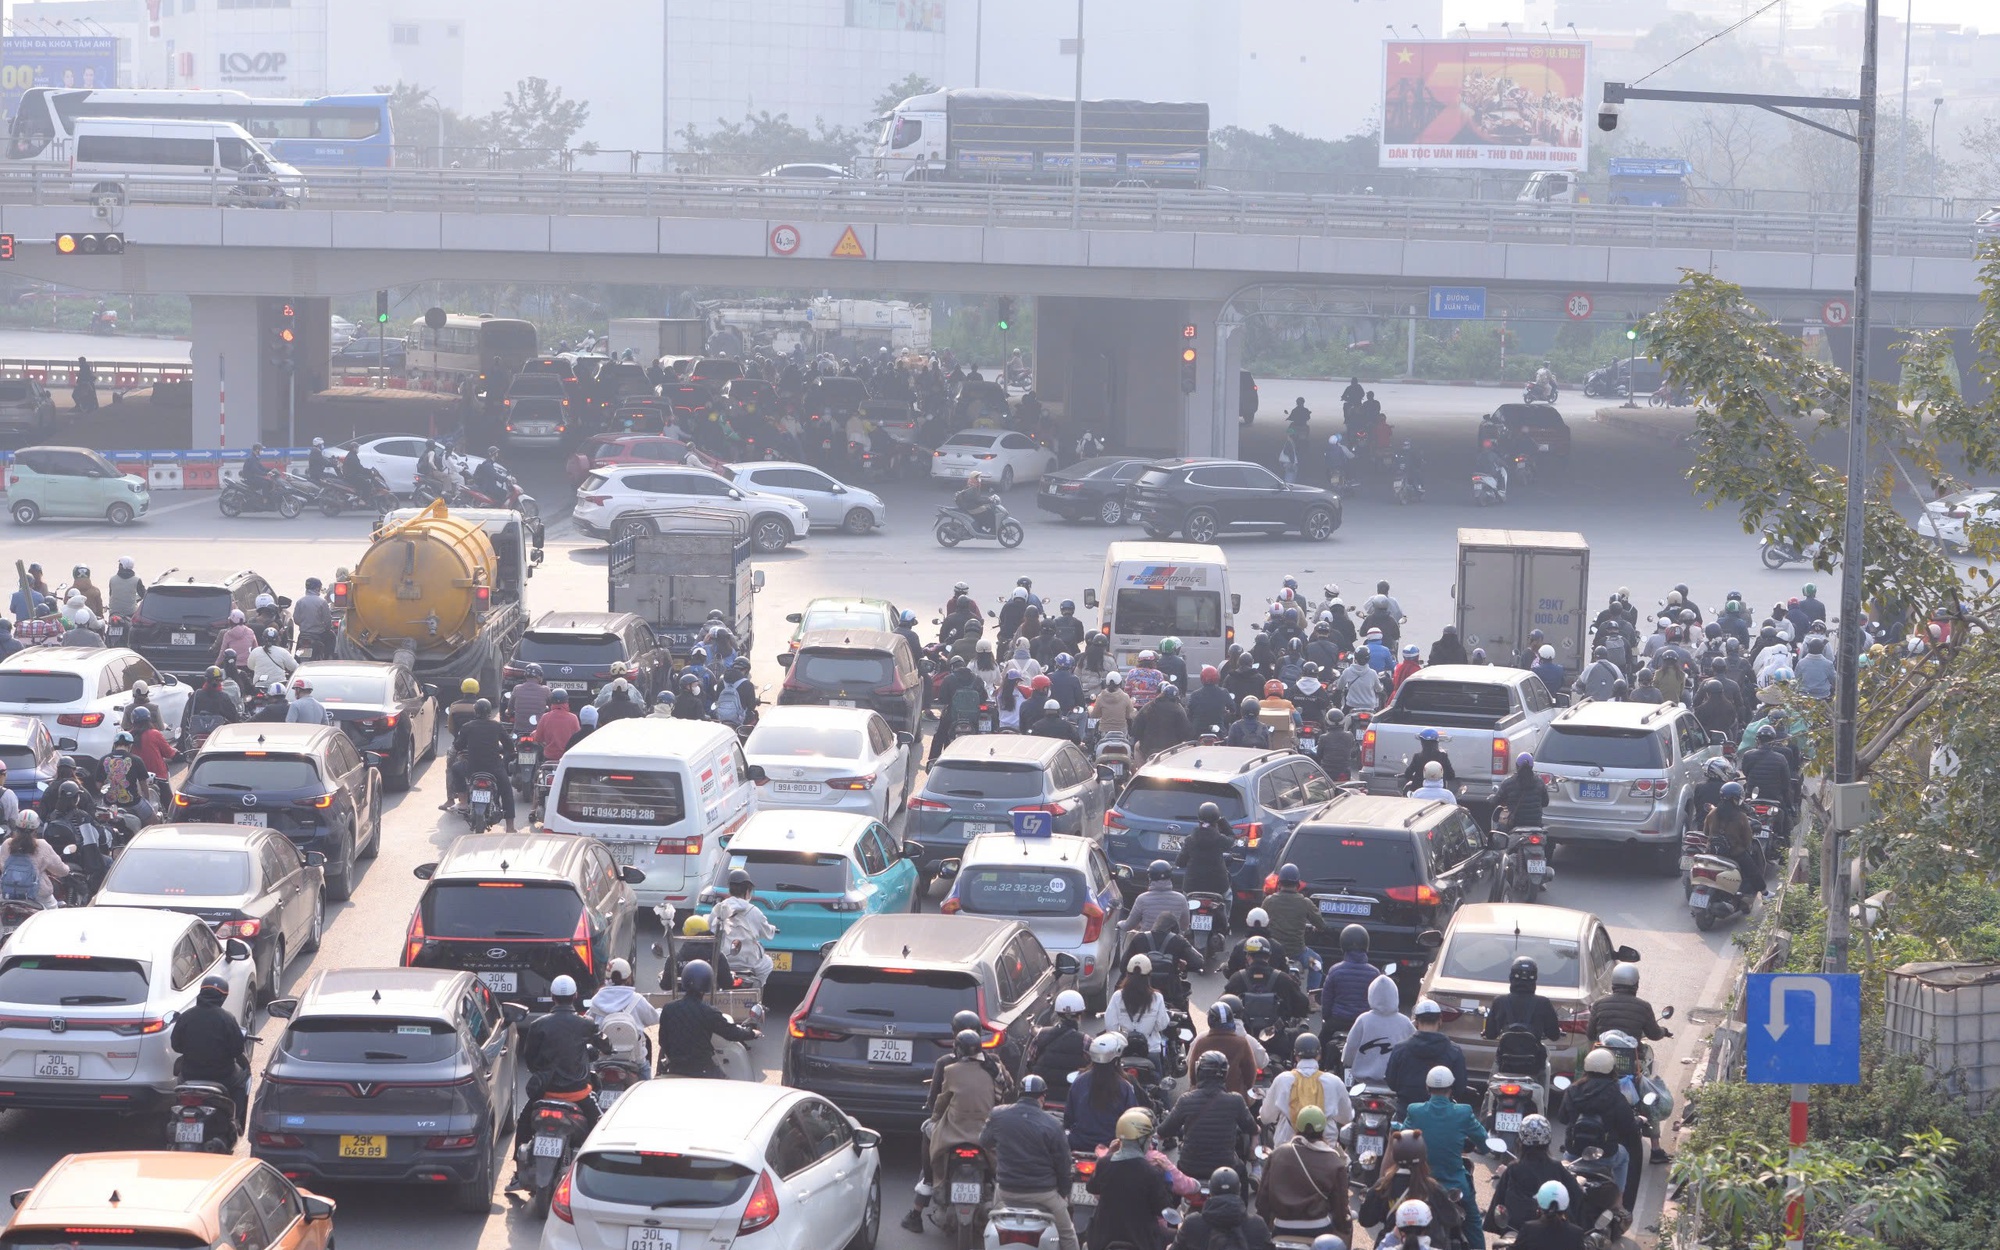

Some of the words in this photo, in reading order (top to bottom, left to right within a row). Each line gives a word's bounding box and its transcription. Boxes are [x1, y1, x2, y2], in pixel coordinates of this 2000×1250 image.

[14, 41, 33, 49] VIỆN
[75, 40, 92, 48] TÂM
[219, 52, 287, 74] LOOP
[1388, 148, 1407, 159] DÂN
[1411, 148, 1428, 160] TỘC
[1487, 148, 1506, 160] THỦ
[1509, 149, 1523, 161] ĐÔ
[1526, 150, 1546, 161] ANH
[1549, 149, 1577, 162] HÙNG
[1443, 302, 1461, 311] XUÂN
[1184, 326, 1195, 337] 23
[1538, 599, 1564, 611] 29KT
[1534, 614, 1569, 624] 006.49
[778, 783, 817, 792] 99A-800.83
[1582, 789, 1606, 797] 056.05
[243, 813, 258, 821] 30L
[597, 807, 637, 819] 0942.859
[638, 809, 655, 819] 286
[1022, 815, 1042, 834] G7
[998, 883, 1012, 891] 32
[1013, 883, 1027, 892] 32
[1028, 884, 1041, 892] 32
[1320, 901, 1369, 914] 80A-012.86
[488, 973, 505, 982] 30K
[881, 1040, 899, 1050] 30L
[48, 1055, 67, 1065] 30L
[872, 1049, 907, 1061] 274.02
[39, 1066, 75, 1076] 406.36
[353, 1135, 372, 1146] 29K
[344, 1146, 381, 1157] 049.89
[642, 1228, 664, 1240] 30L
